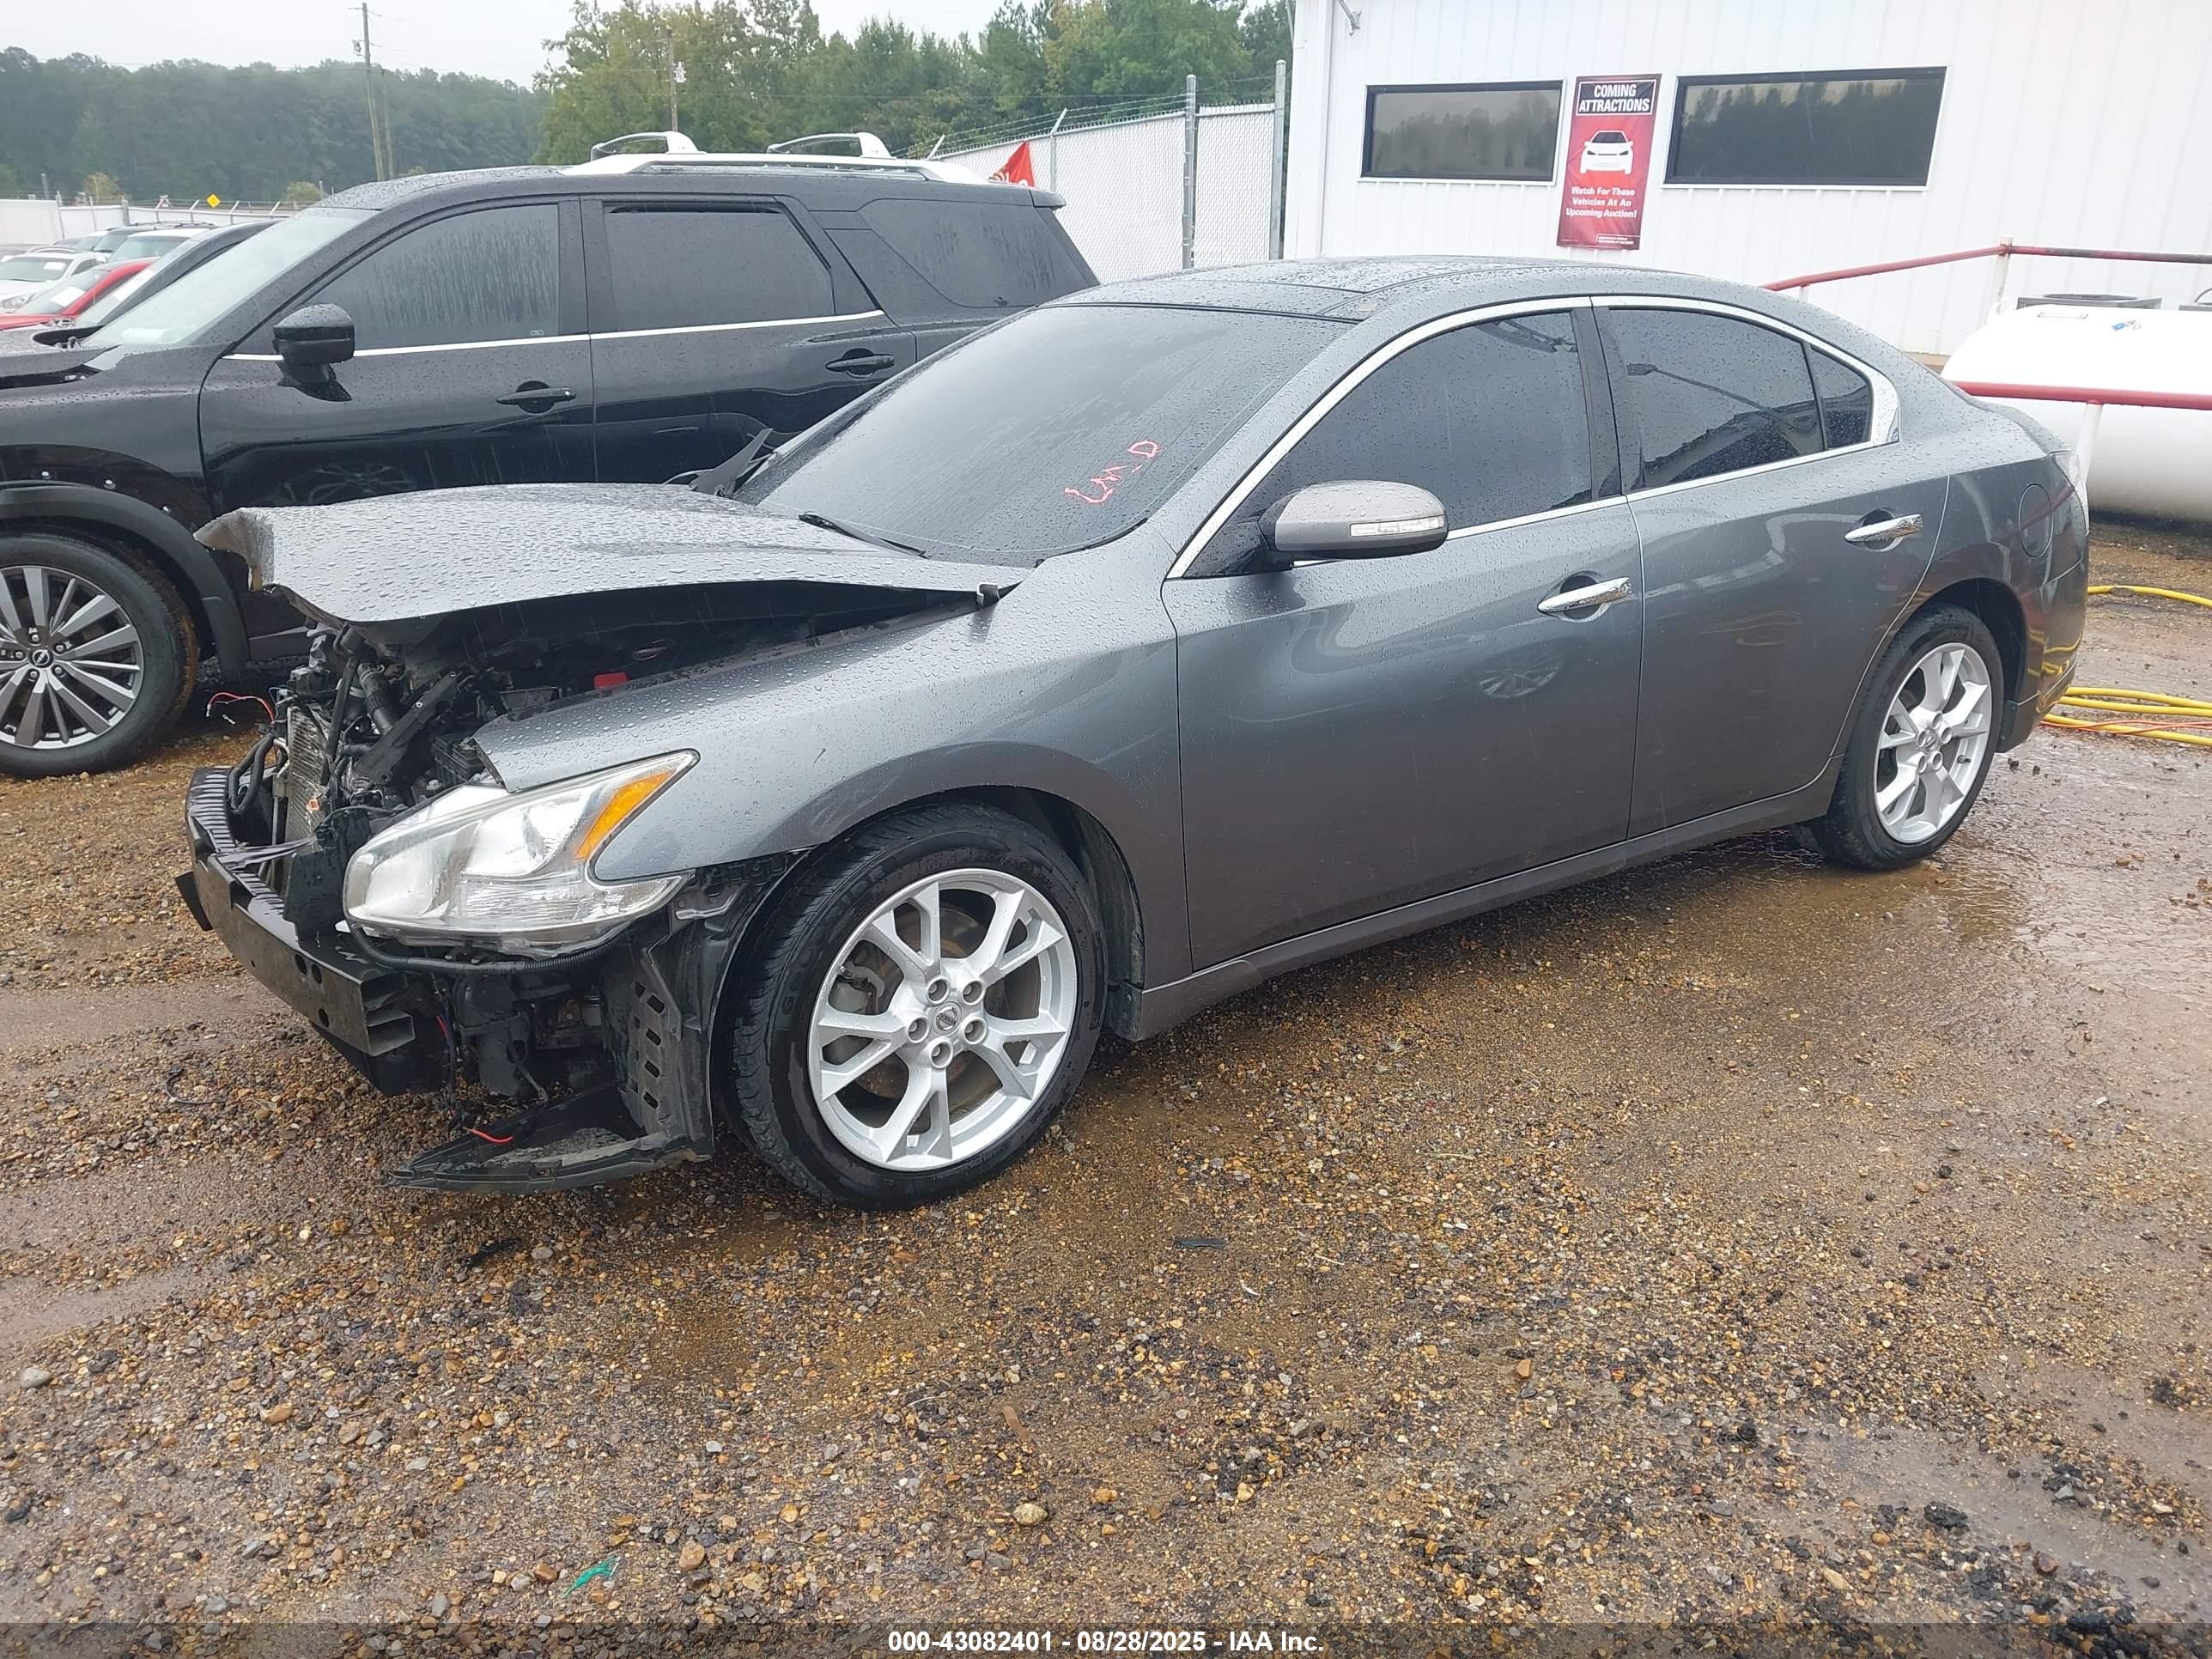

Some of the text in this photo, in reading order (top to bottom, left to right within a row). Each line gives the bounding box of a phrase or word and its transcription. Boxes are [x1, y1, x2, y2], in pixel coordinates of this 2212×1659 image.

[1594, 84, 1637, 98] COMING
[1578, 98, 1650, 112] ATTRACTIONS
[1612, 187, 1636, 196] These
[1572, 197, 1632, 207] Vehicles At An
[1565, 208, 1637, 219] Upcoming Auction!
